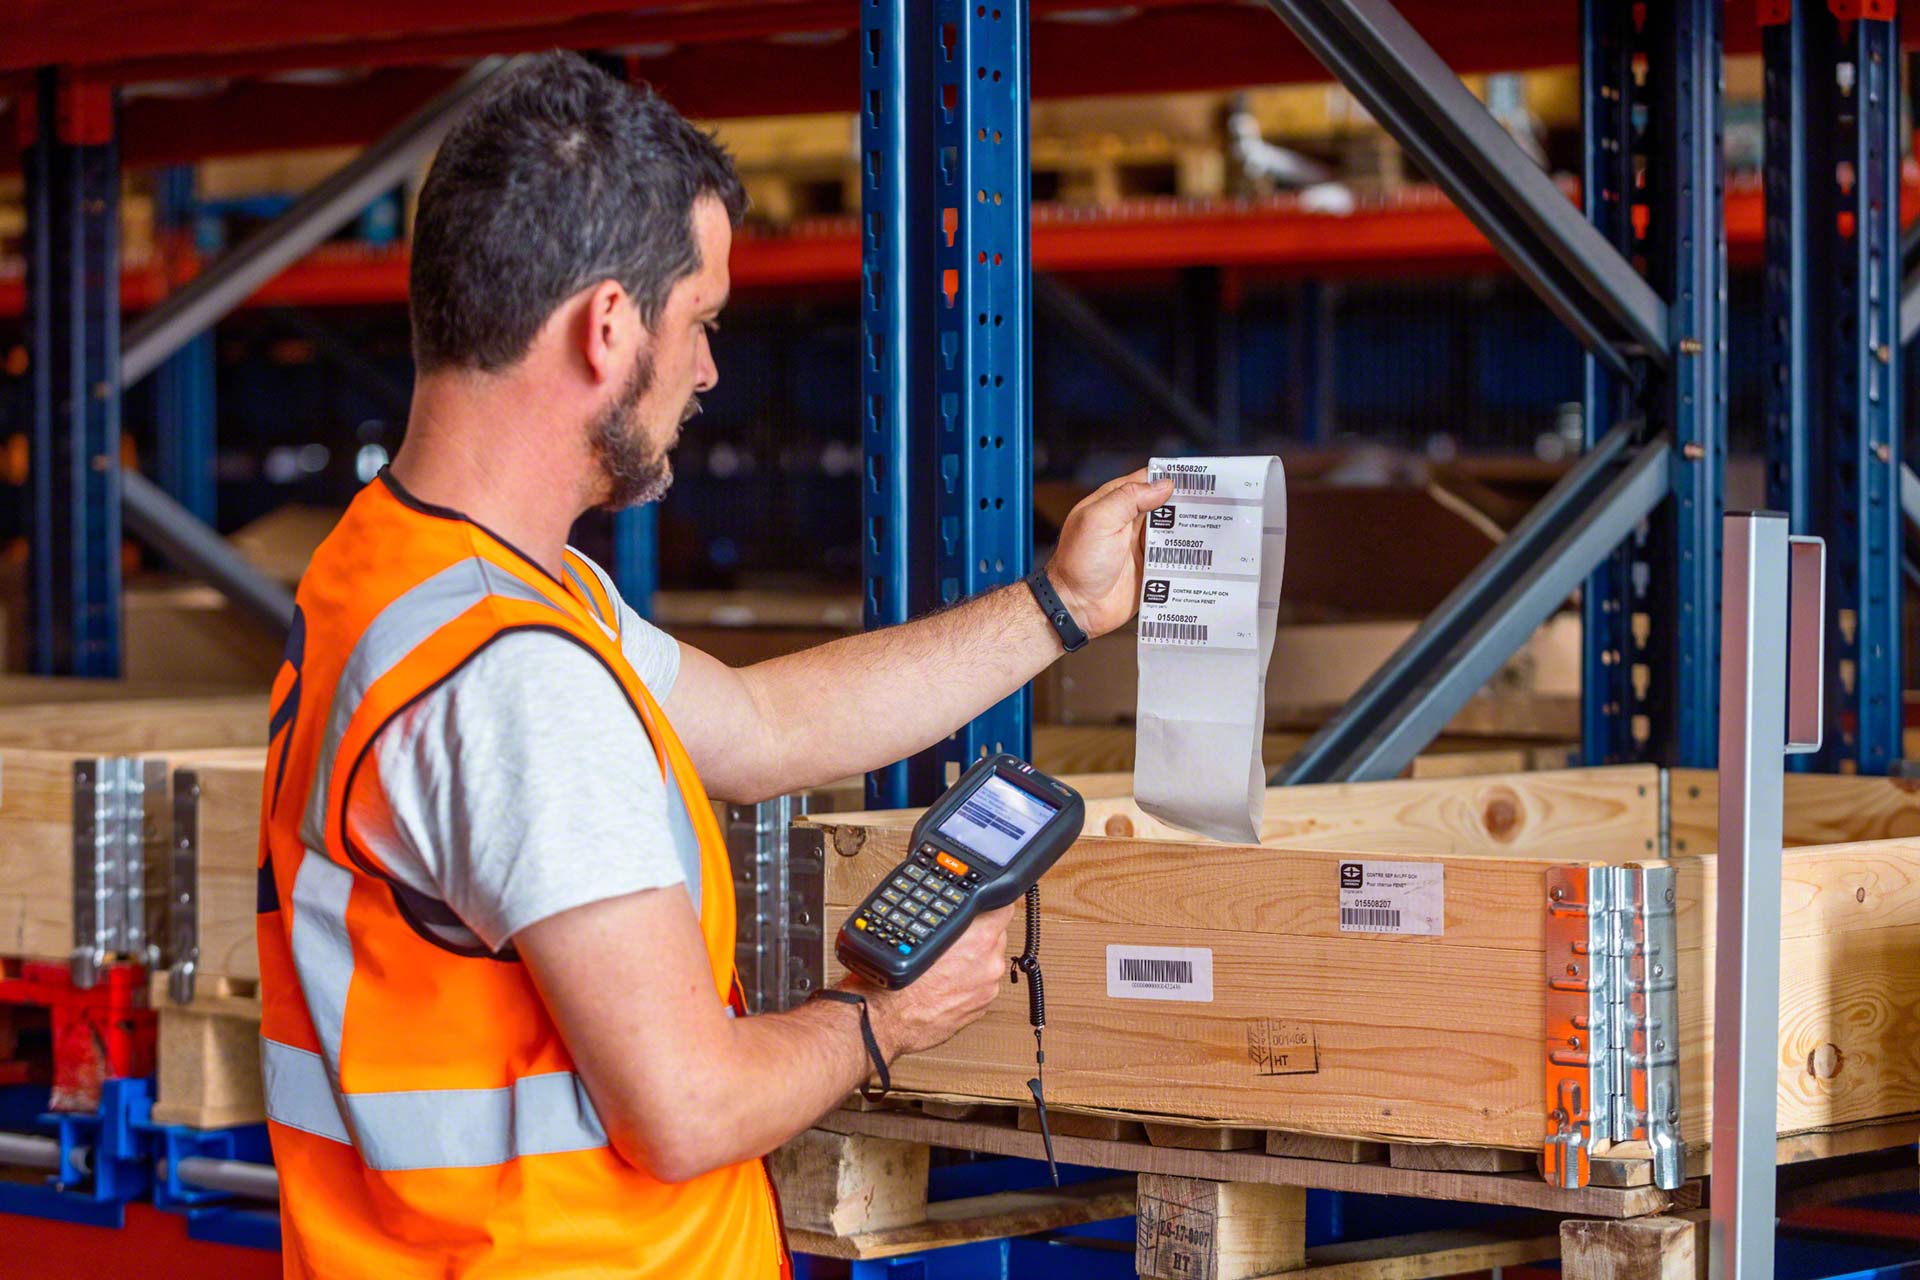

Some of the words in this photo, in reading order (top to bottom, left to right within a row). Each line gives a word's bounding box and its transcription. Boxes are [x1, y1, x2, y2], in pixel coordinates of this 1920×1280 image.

[1166, 464, 1208, 473] 015508207
[1164, 538, 1204, 548] 015508207
[1157, 613, 1198, 623] 015508207
[945, 858, 959, 868] SCAN
[1354, 898, 1392, 908] 015508207
[1274, 1054, 1289, 1067] HT
[1173, 1252, 1191, 1273] HT
